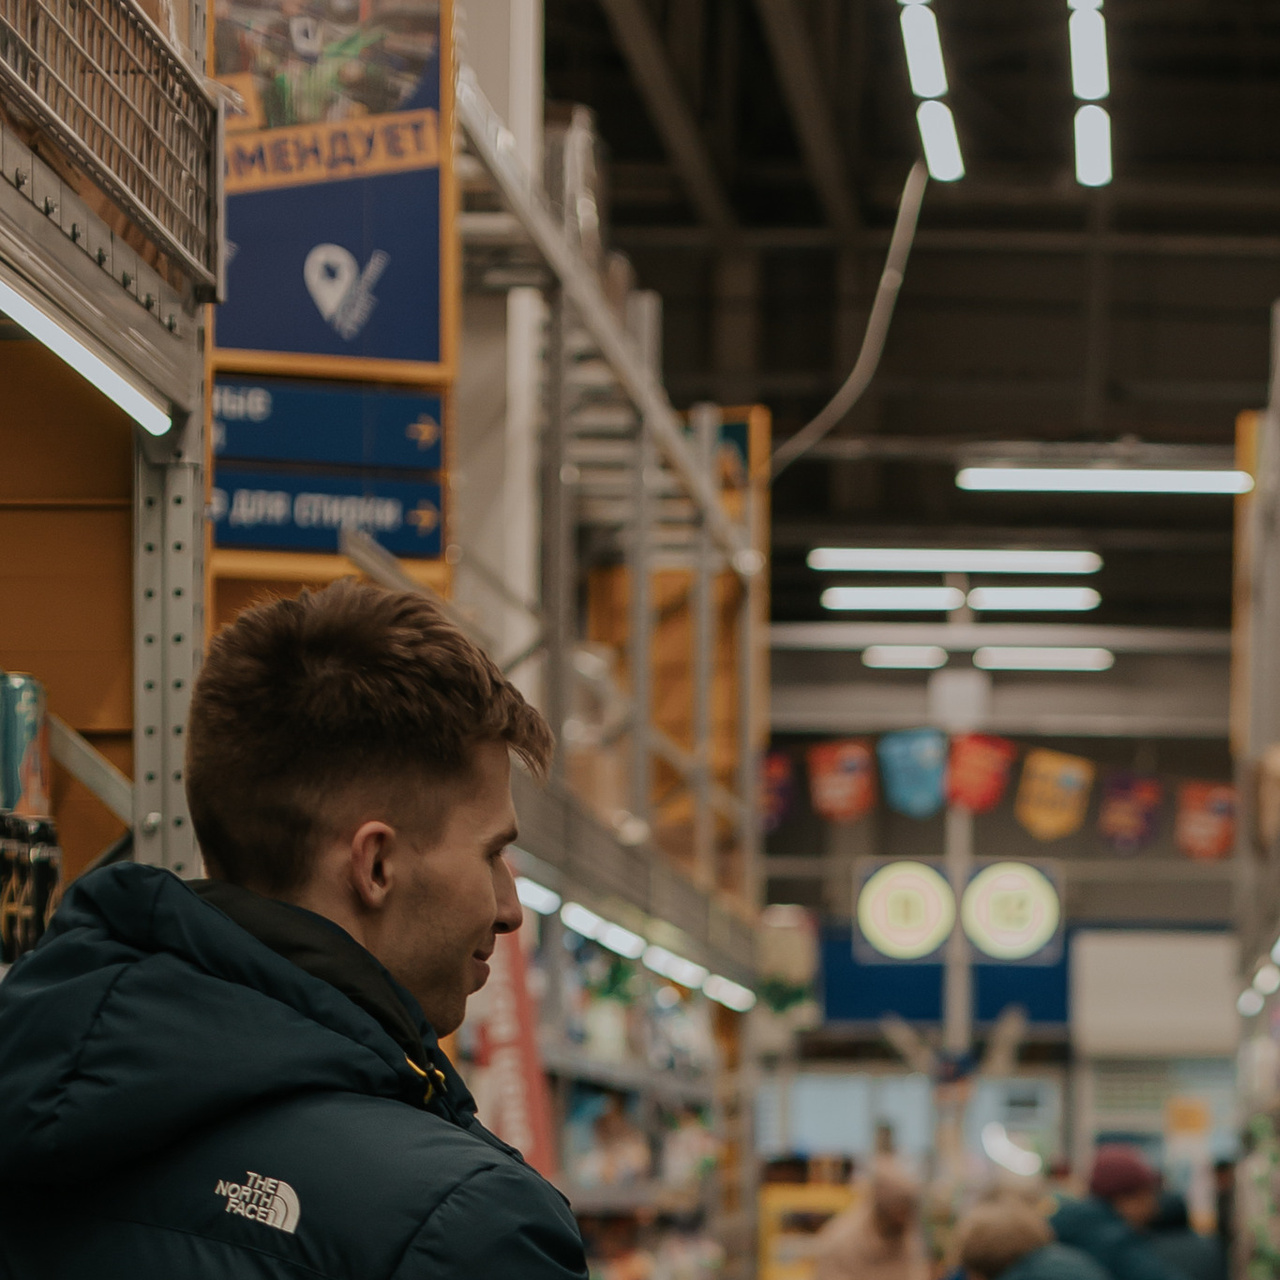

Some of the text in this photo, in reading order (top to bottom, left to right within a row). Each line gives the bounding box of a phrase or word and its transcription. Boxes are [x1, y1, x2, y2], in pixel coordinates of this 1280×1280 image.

[224, 118, 425, 178] МЕНДУЕТ
[214, 1179, 275, 1208] NORTH
[246, 1171, 280, 1195] THE
[225, 1198, 269, 1223] FACE
